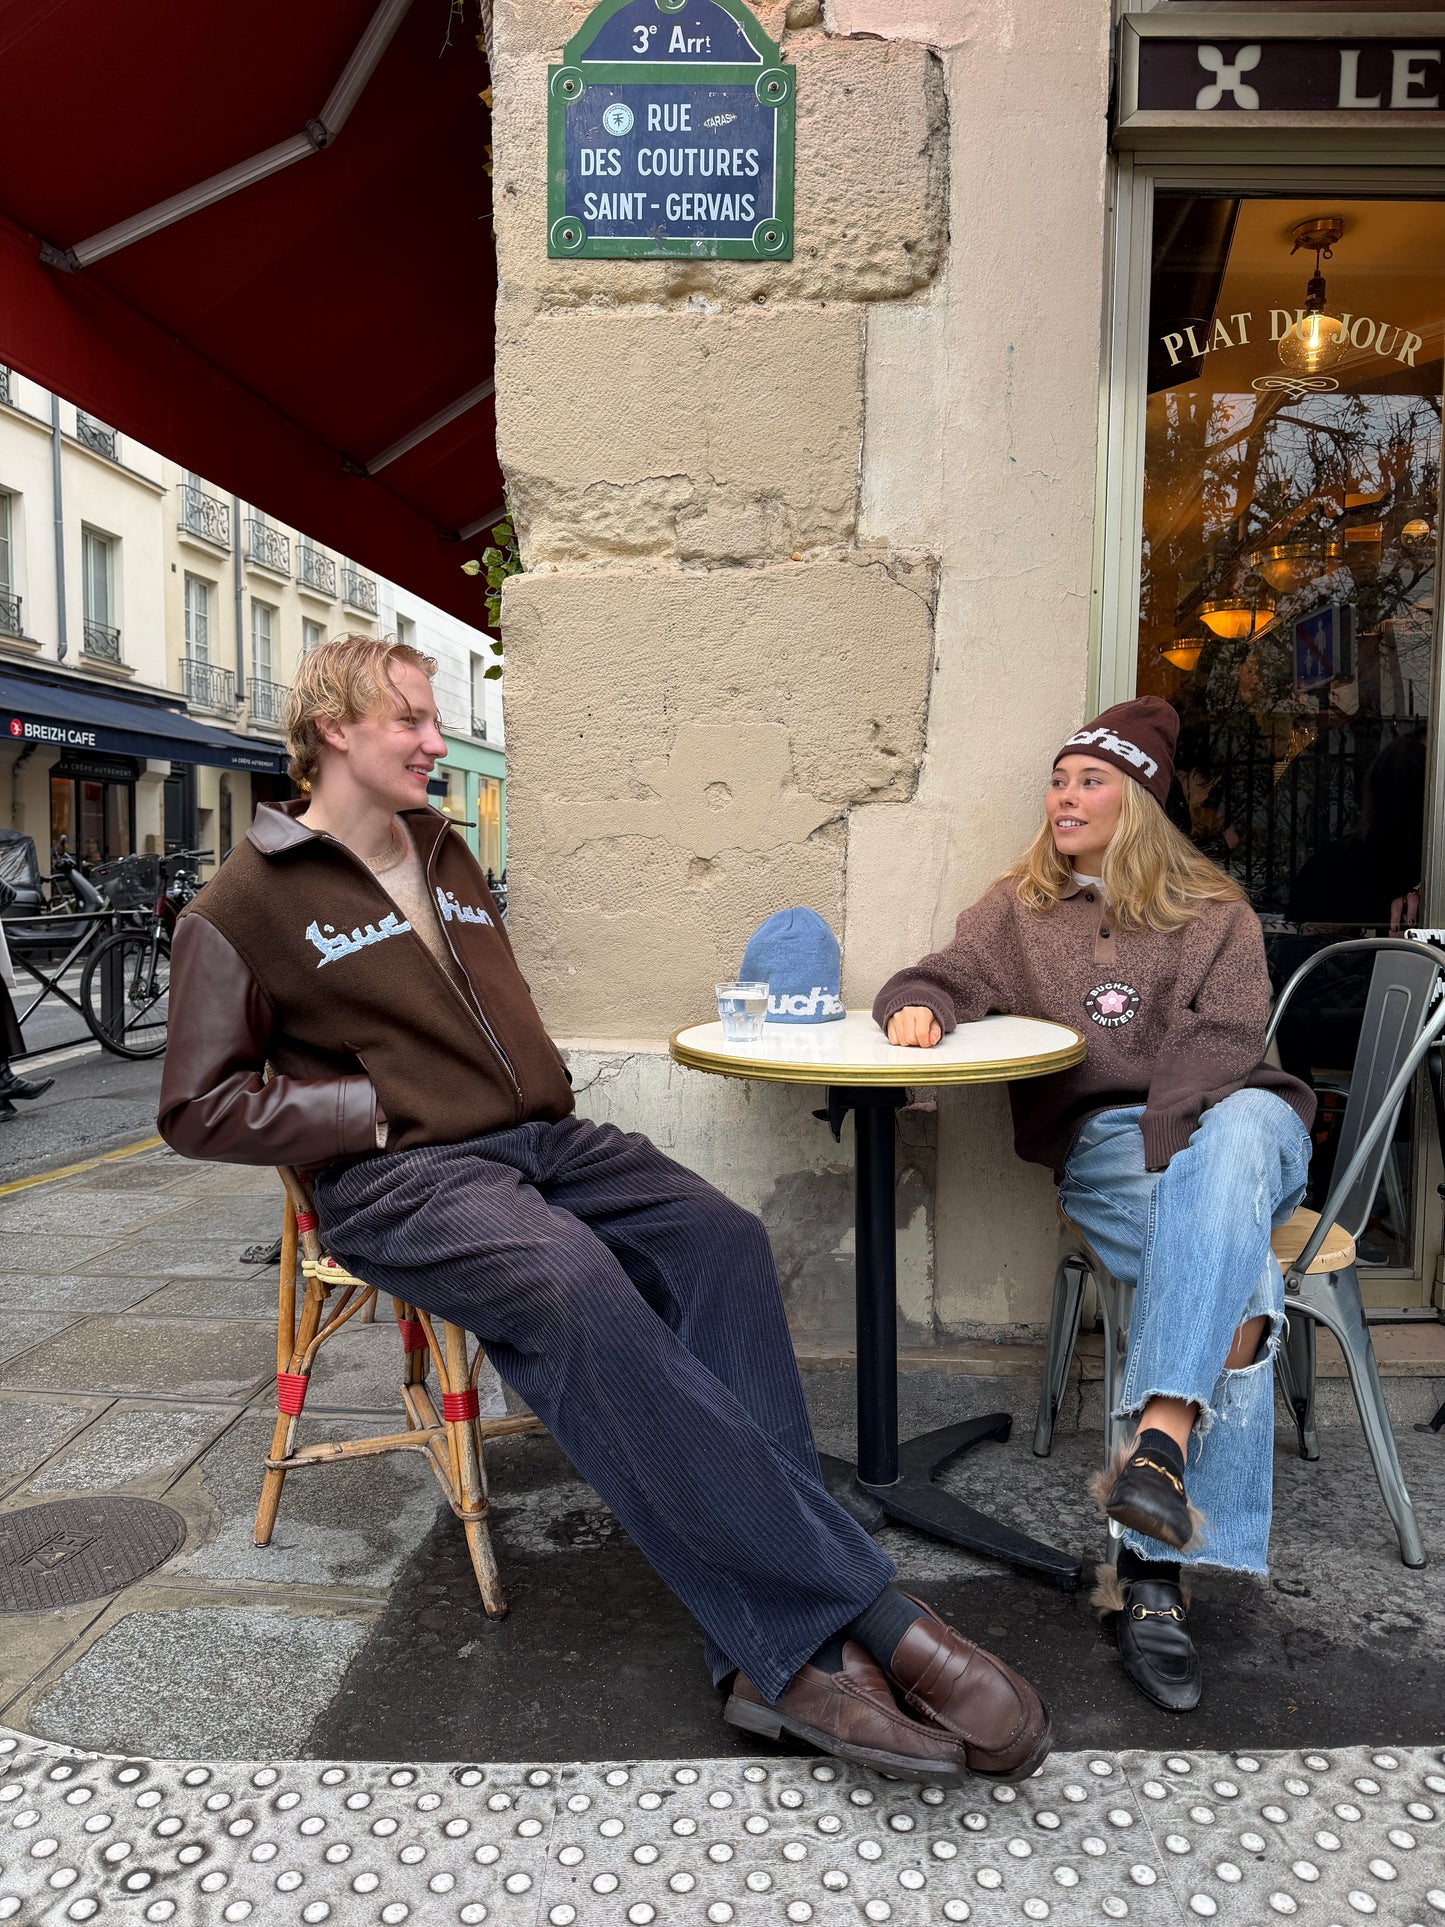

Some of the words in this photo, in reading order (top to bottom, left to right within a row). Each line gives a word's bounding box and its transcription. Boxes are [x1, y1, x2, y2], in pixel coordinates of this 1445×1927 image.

[1336, 49, 1442, 108] LE
[648, 104, 692, 132] RUE
[580, 148, 621, 176] DES
[637, 148, 760, 177] COUTURES
[1161, 312, 1253, 367] PLAT
[1268, 309, 1319, 341] DU
[1331, 312, 1423, 367] JOUR
[24, 723, 66, 742] BREIZH
[67, 730, 96, 746] CAFE
[94, 767, 132, 777] AUTREMENT
[1090, 983, 1136, 996] BUCHAN
[1091, 1009, 1134, 1026] UNITED
